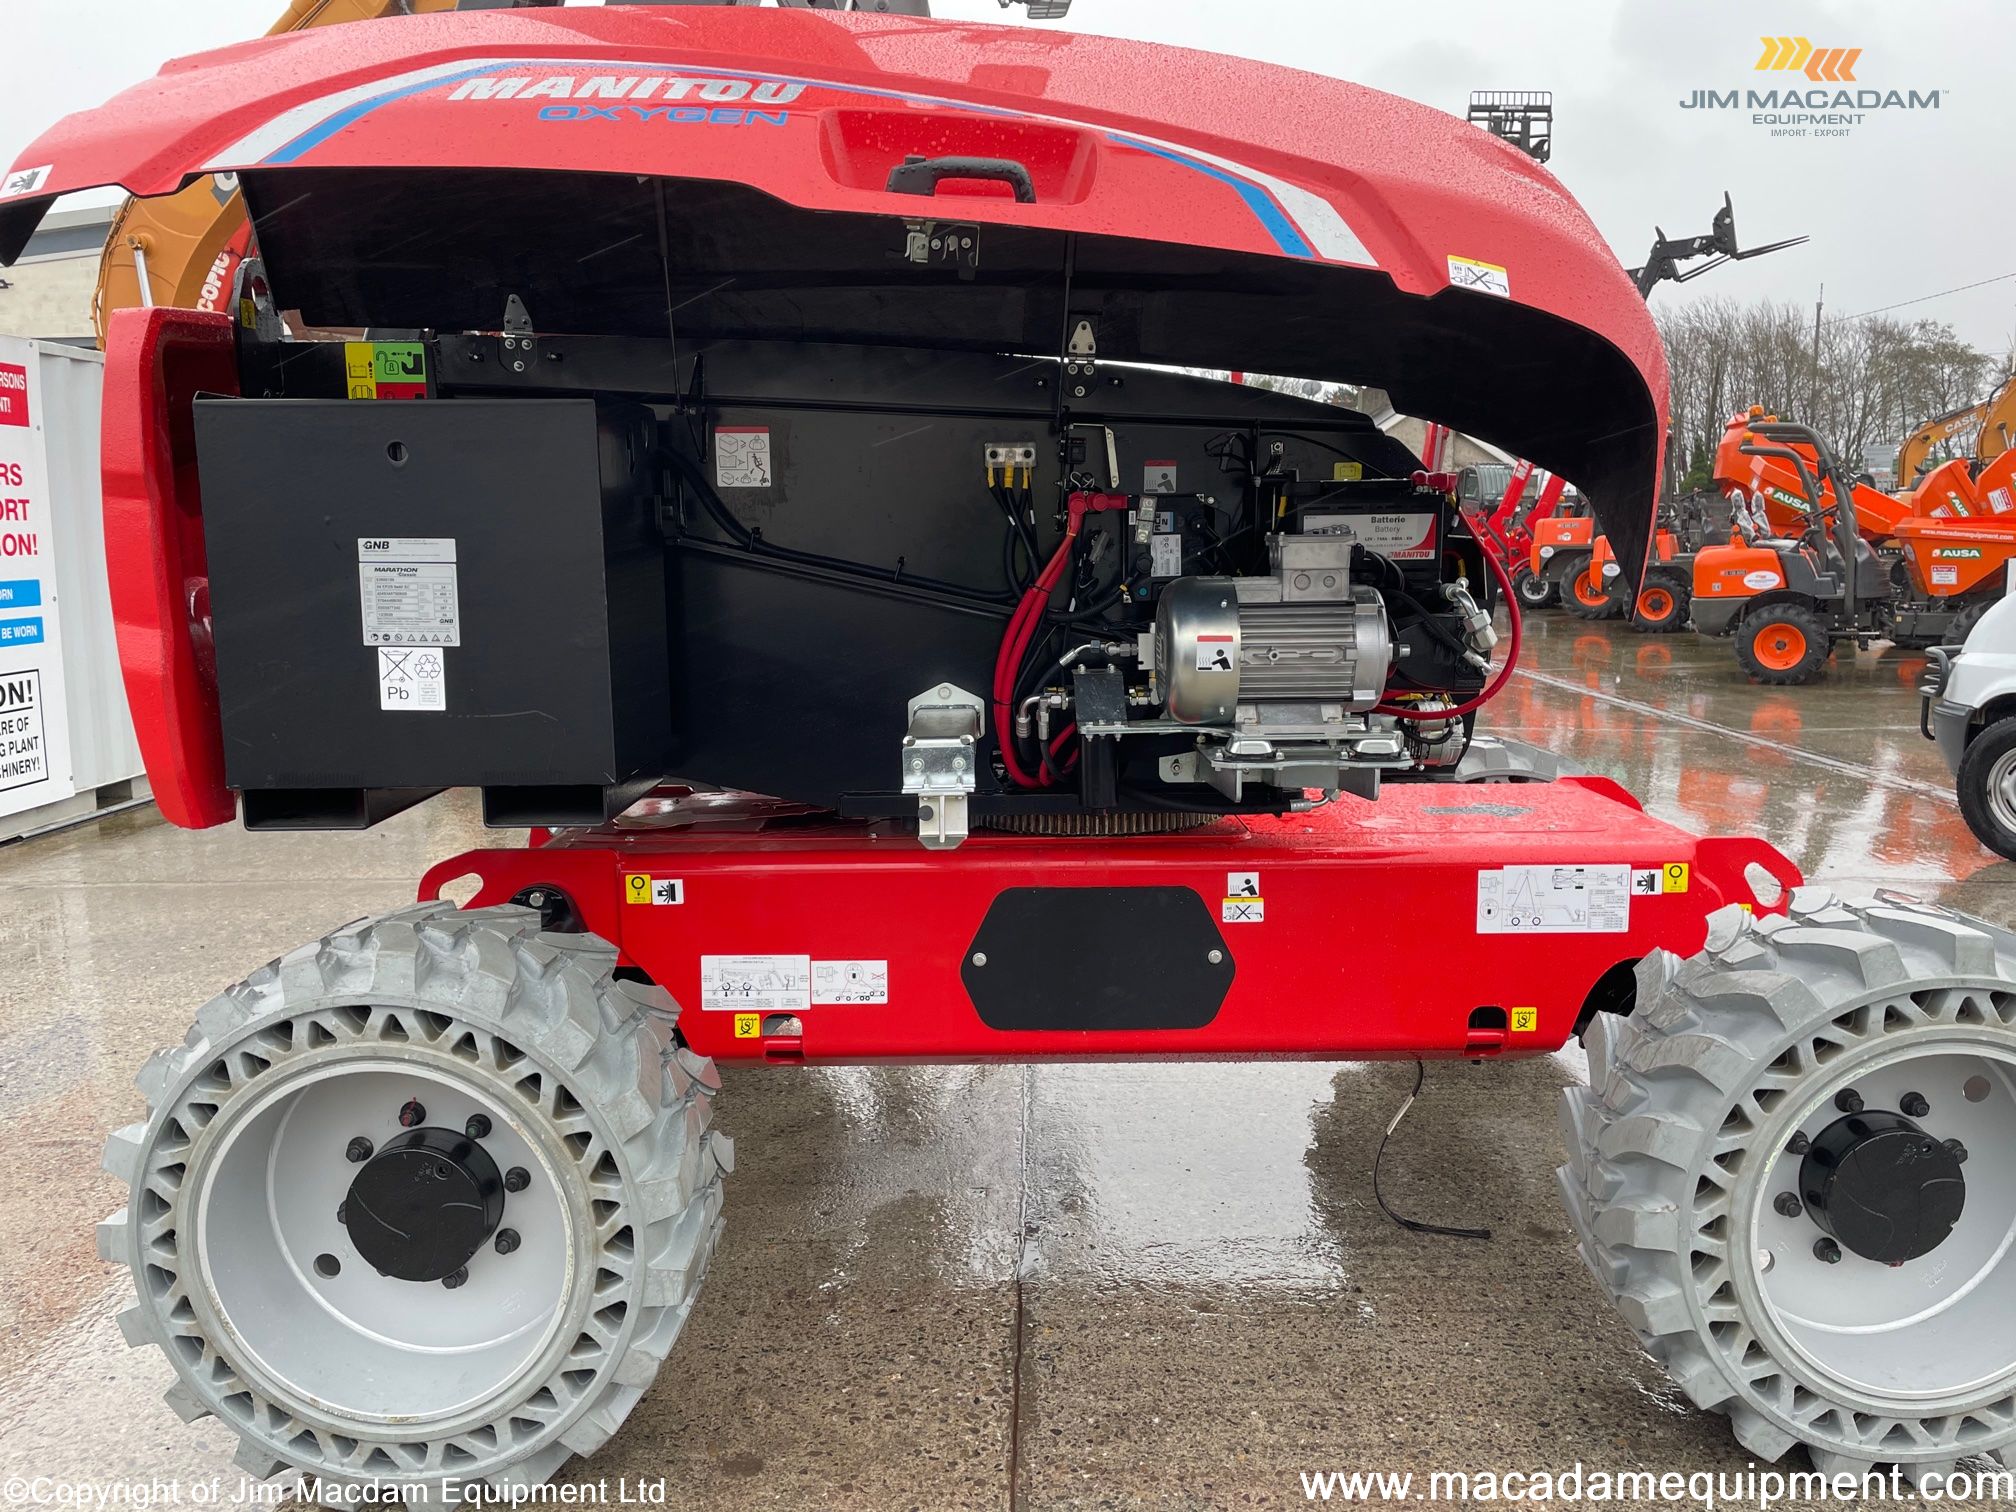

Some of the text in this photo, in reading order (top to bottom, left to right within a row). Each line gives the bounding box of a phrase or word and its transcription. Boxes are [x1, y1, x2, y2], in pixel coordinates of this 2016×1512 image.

[447, 76, 806, 104] MANITOU
[537, 105, 789, 126] OXYGEN
[1945, 412, 1977, 433] CASE
[1773, 491, 1811, 513] AUSA
[1371, 516, 1406, 524] Batterie
[1375, 526, 1401, 535] Battery
[363, 540, 390, 550] GNB
[1942, 549, 1980, 557] AUSA
[1393, 551, 1430, 559] MANITOU
[1, 625, 38, 640] BE WORN
[387, 686, 410, 700] Pb
[0, 717, 29, 736] RE OF
[9, 736, 39, 756] PLANT
[0, 757, 40, 779] HINERY!
